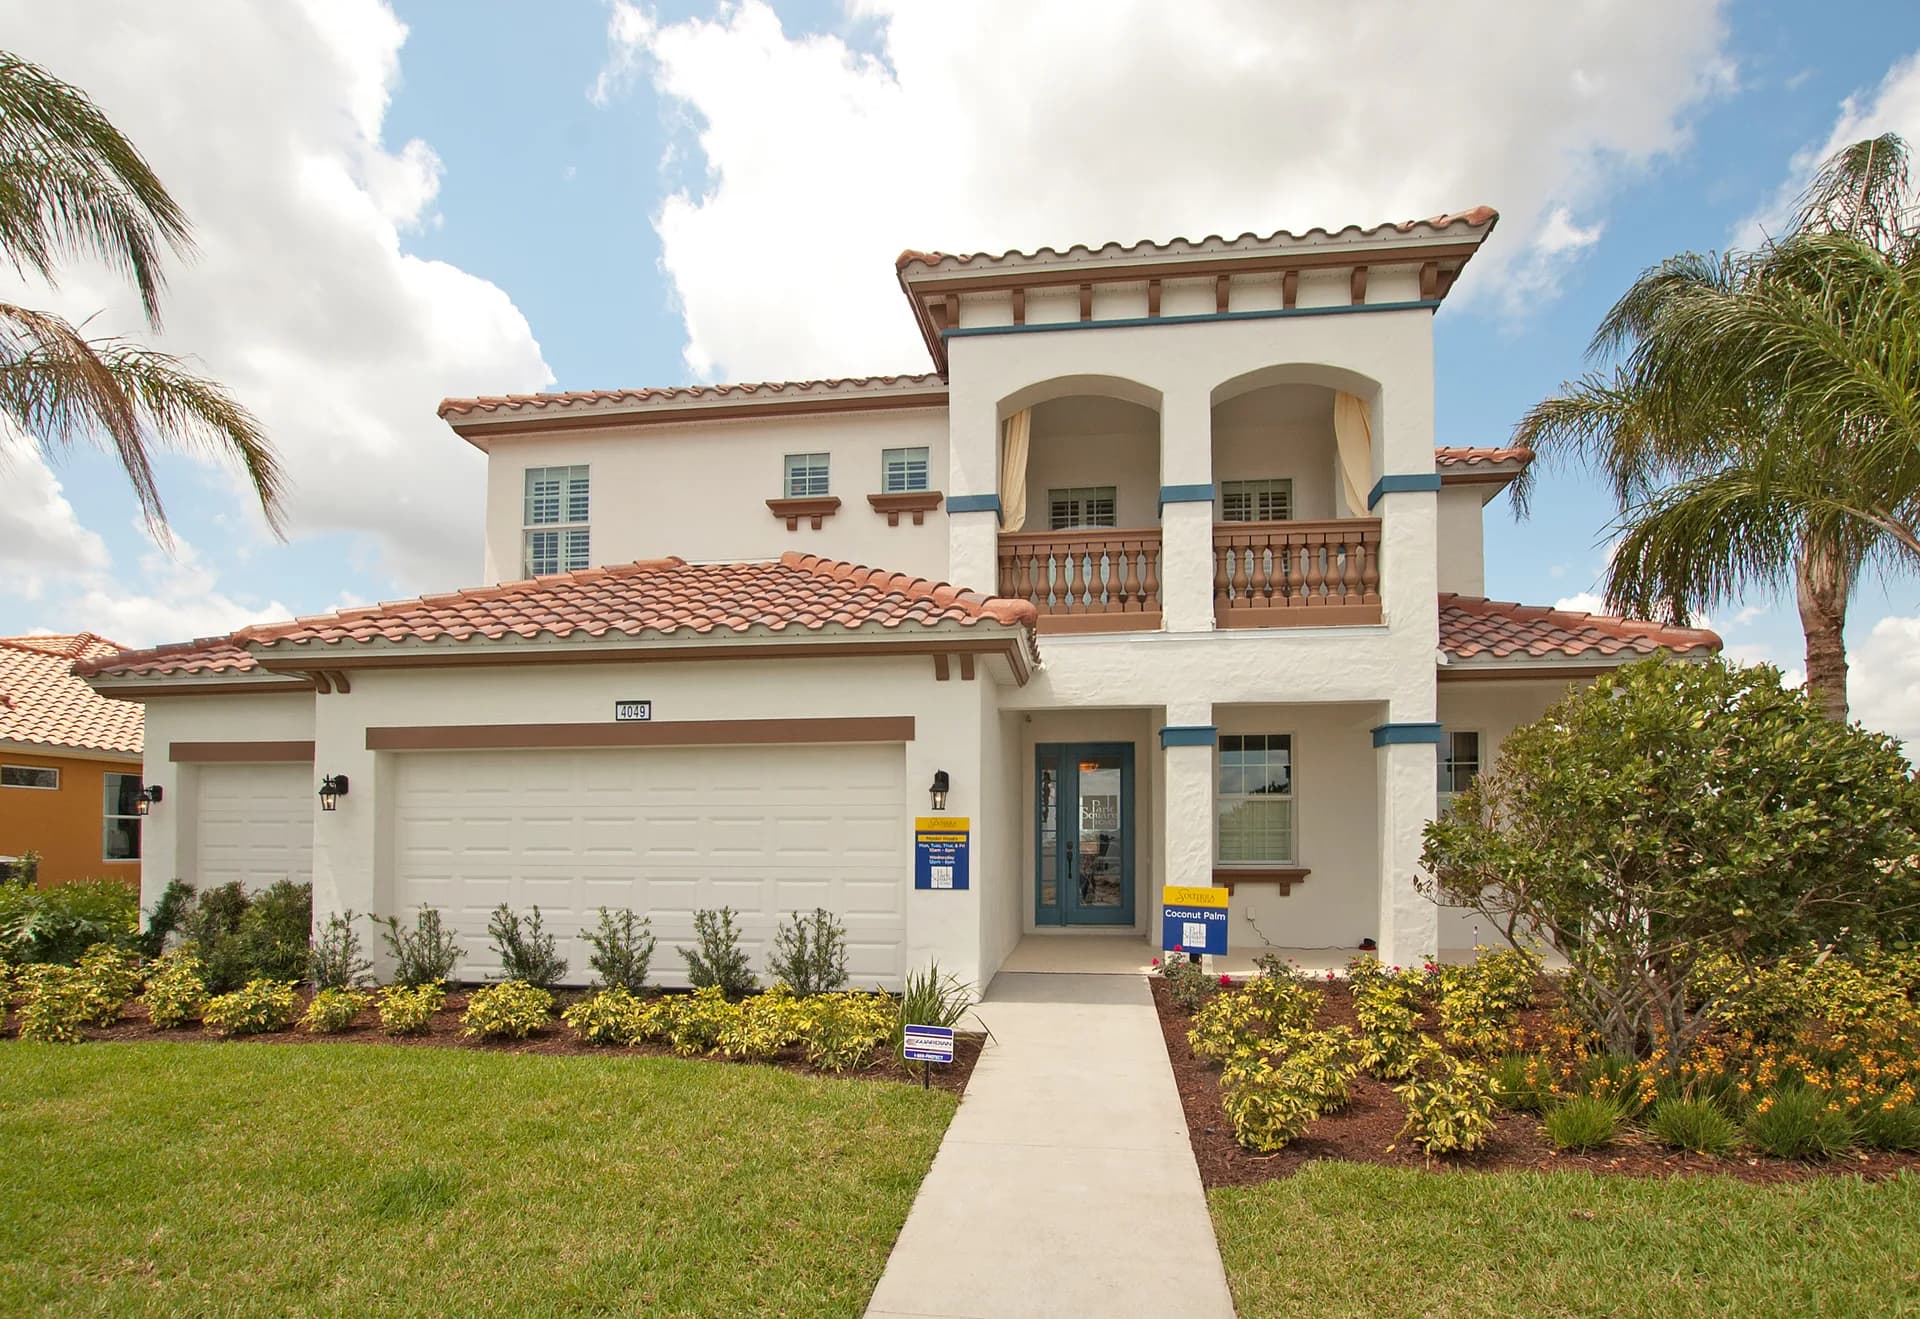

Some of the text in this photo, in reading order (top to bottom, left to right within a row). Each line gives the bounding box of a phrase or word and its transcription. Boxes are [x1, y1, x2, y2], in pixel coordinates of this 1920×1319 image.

[621, 705, 645, 718] 4049
[1165, 909, 1226, 921] Coconut Palm
